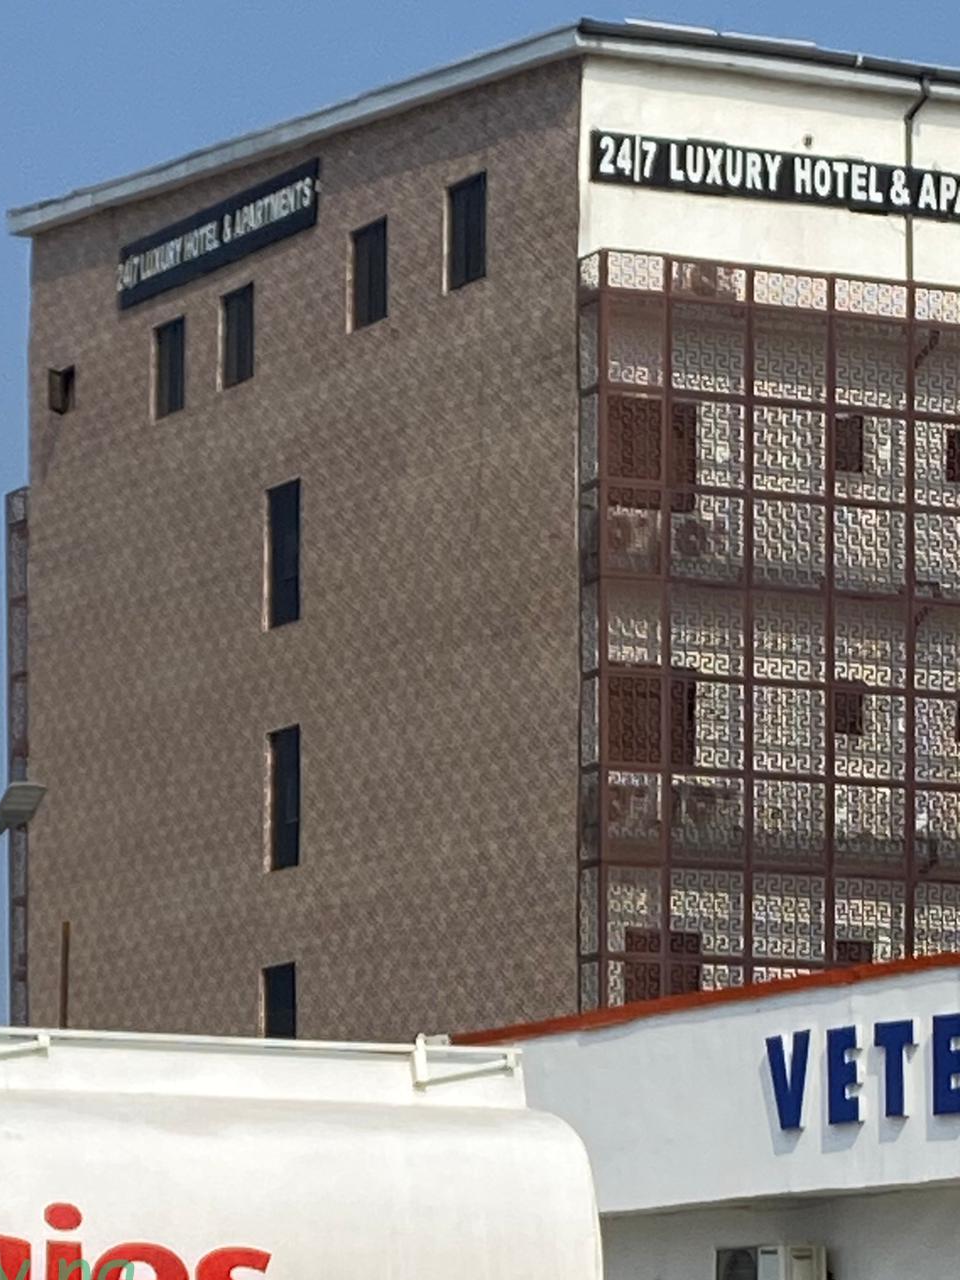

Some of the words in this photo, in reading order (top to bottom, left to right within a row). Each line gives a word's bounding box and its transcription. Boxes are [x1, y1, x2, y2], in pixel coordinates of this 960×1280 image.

[669, 143, 783, 192] LUXURY
[794, 157, 884, 204] HOTEL
[890, 168, 911, 206] &
[140, 236, 183, 280] LUXURY
[183, 220, 220, 260] HOTEL
[223, 213, 232, 243] &
[233, 176, 314, 237] APARTMENTS
[765, 1013, 960, 1130] VETE
